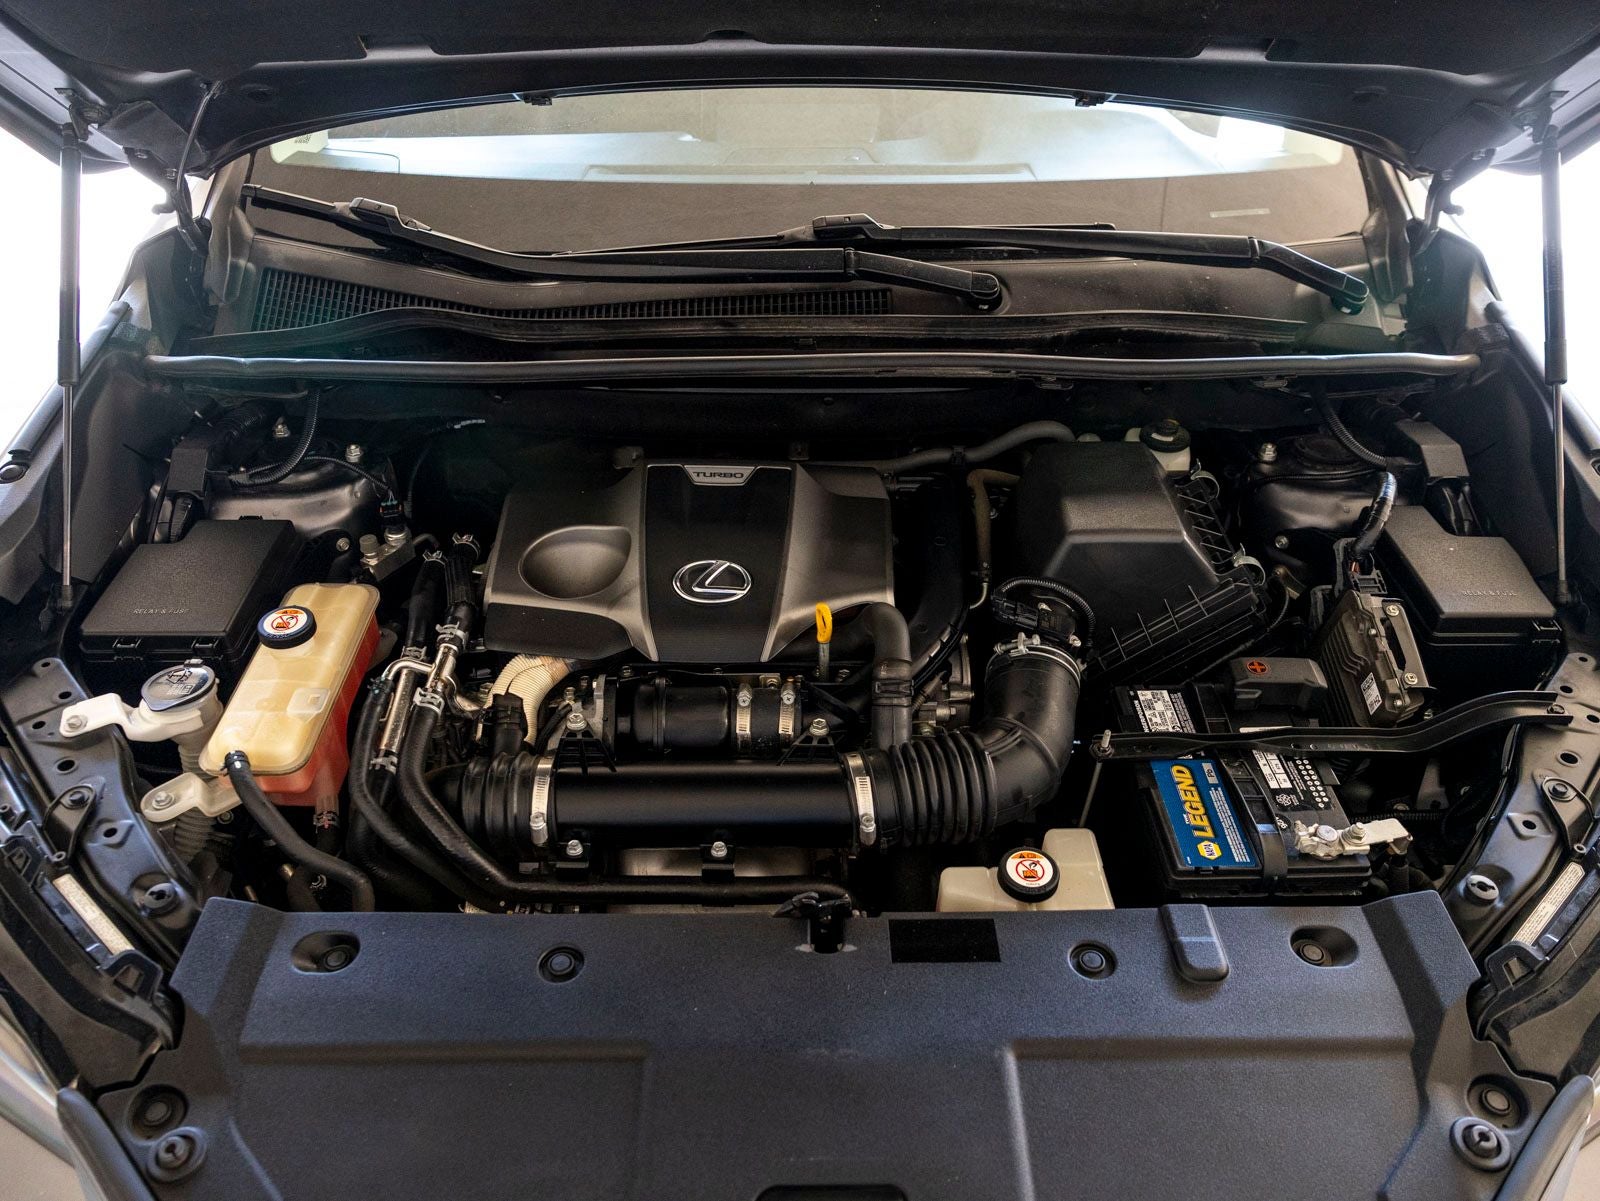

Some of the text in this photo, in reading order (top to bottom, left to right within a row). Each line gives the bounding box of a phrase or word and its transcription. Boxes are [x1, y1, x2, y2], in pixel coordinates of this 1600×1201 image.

[692, 471, 744, 479] TURBO
[1171, 765, 1215, 838] LEGEND
[1203, 843, 1216, 857] NAPA
